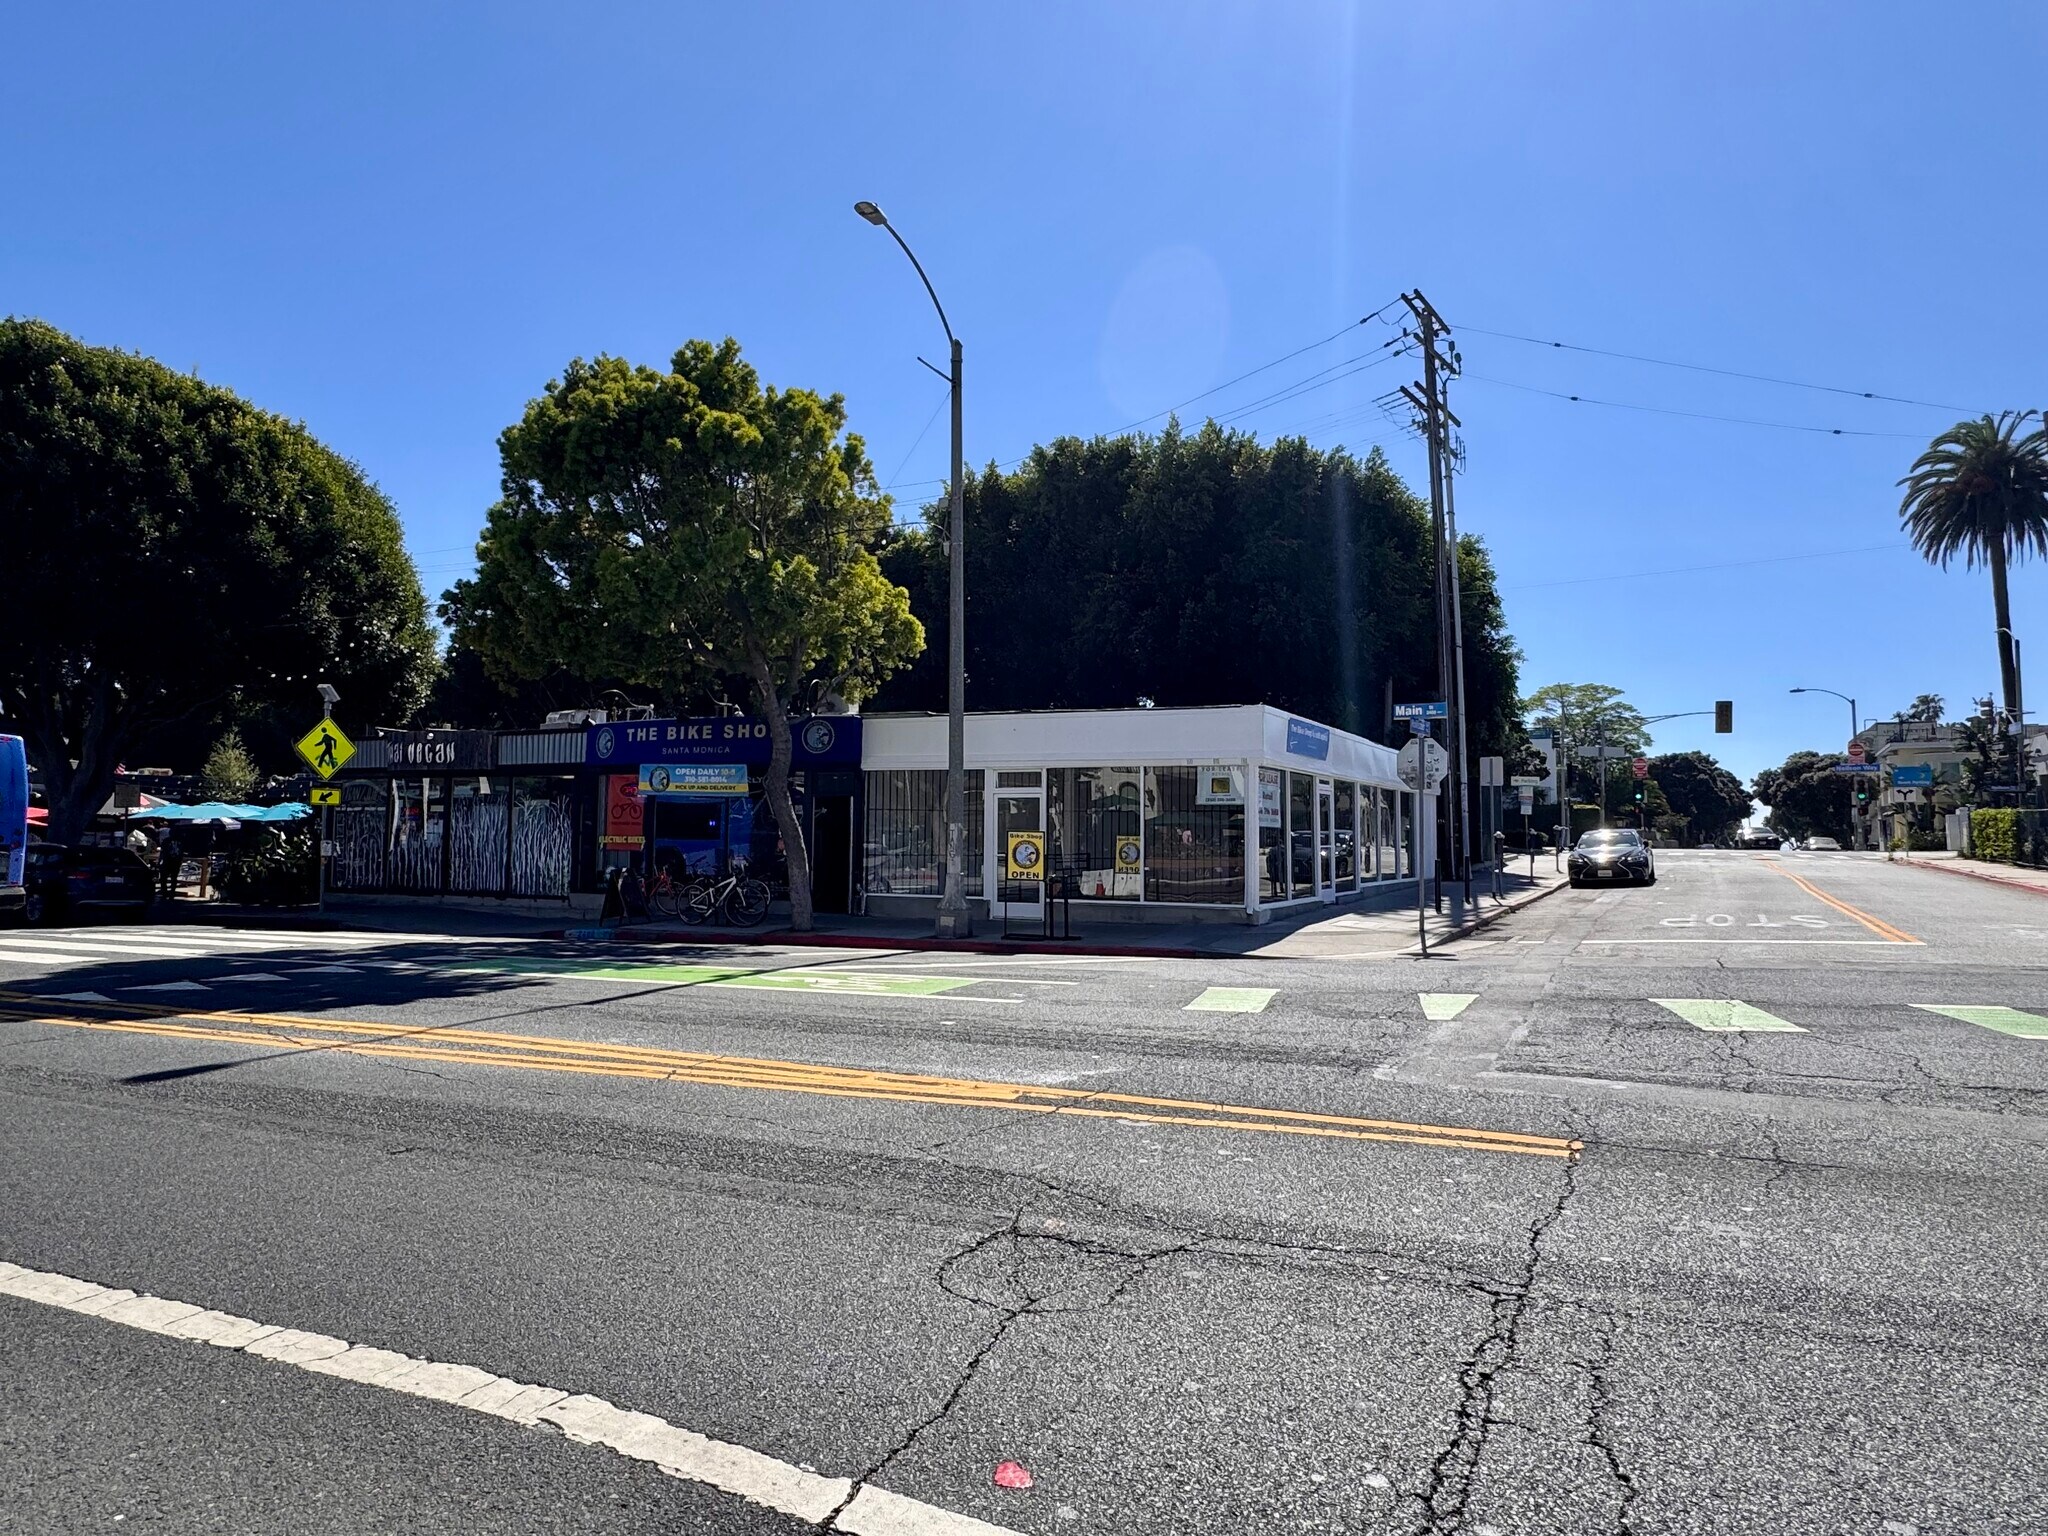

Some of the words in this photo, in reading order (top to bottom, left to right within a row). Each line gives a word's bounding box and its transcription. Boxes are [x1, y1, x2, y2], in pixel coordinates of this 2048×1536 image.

[1395, 705, 1423, 716] Main
[627, 728, 658, 742] THE
[666, 725, 713, 741] BIKE
[723, 724, 773, 739] SHO
[661, 747, 690, 755] SANTA
[693, 746, 731, 754] MONICA
[675, 768, 696, 776] OPEN
[697, 768, 720, 776] DAILY
[1011, 871, 1040, 879] OPEN
